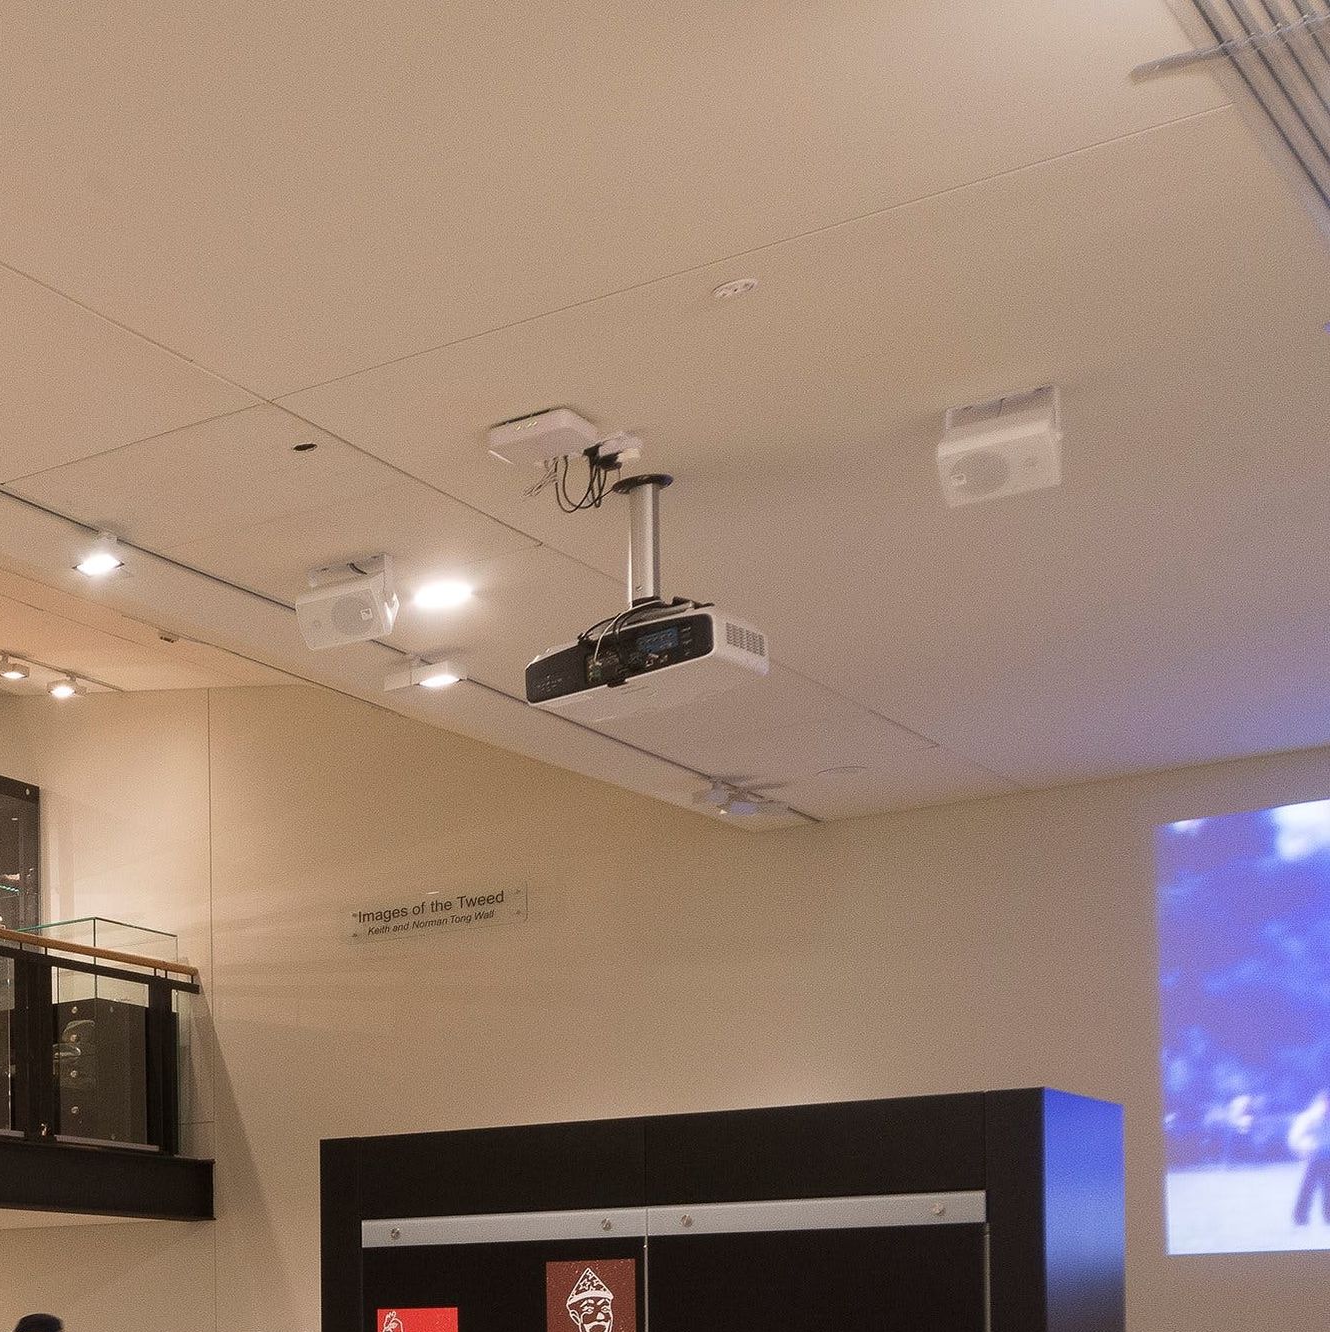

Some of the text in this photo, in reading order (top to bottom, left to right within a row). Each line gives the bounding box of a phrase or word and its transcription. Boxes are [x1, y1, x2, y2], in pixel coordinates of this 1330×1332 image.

[358, 890, 505, 924] Images of the Tweed
[367, 924, 391, 937] Keith
[392, 922, 410, 933] and
[411, 917, 449, 930] Norman
[450, 914, 472, 926] Tong
